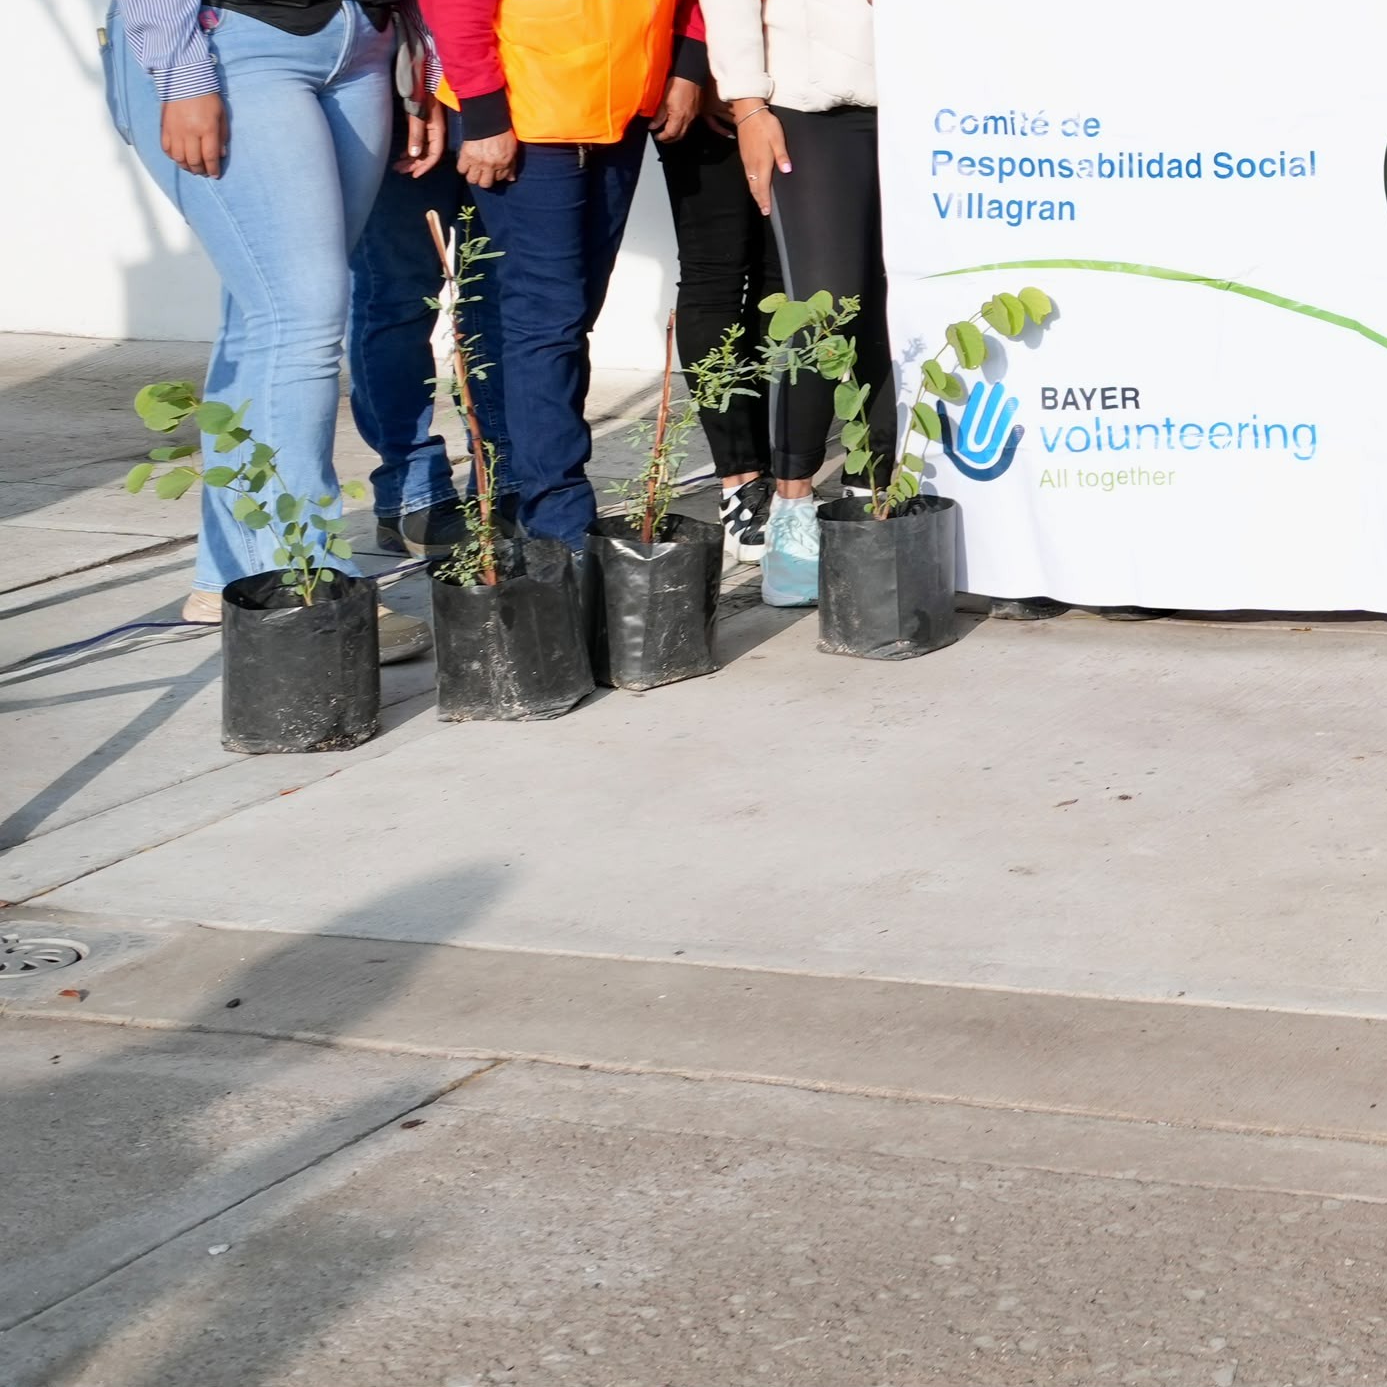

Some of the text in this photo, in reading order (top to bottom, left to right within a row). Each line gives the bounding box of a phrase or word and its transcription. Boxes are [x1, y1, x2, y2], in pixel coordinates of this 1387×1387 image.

[934, 108, 1101, 137] Comité de
[930, 150, 1317, 183] Responsabilidad Social
[933, 193, 1076, 227] Villagran
[1041, 387, 1141, 411] BAYER
[1040, 414, 1318, 461] volunteering
[1039, 468, 1176, 492] All together
